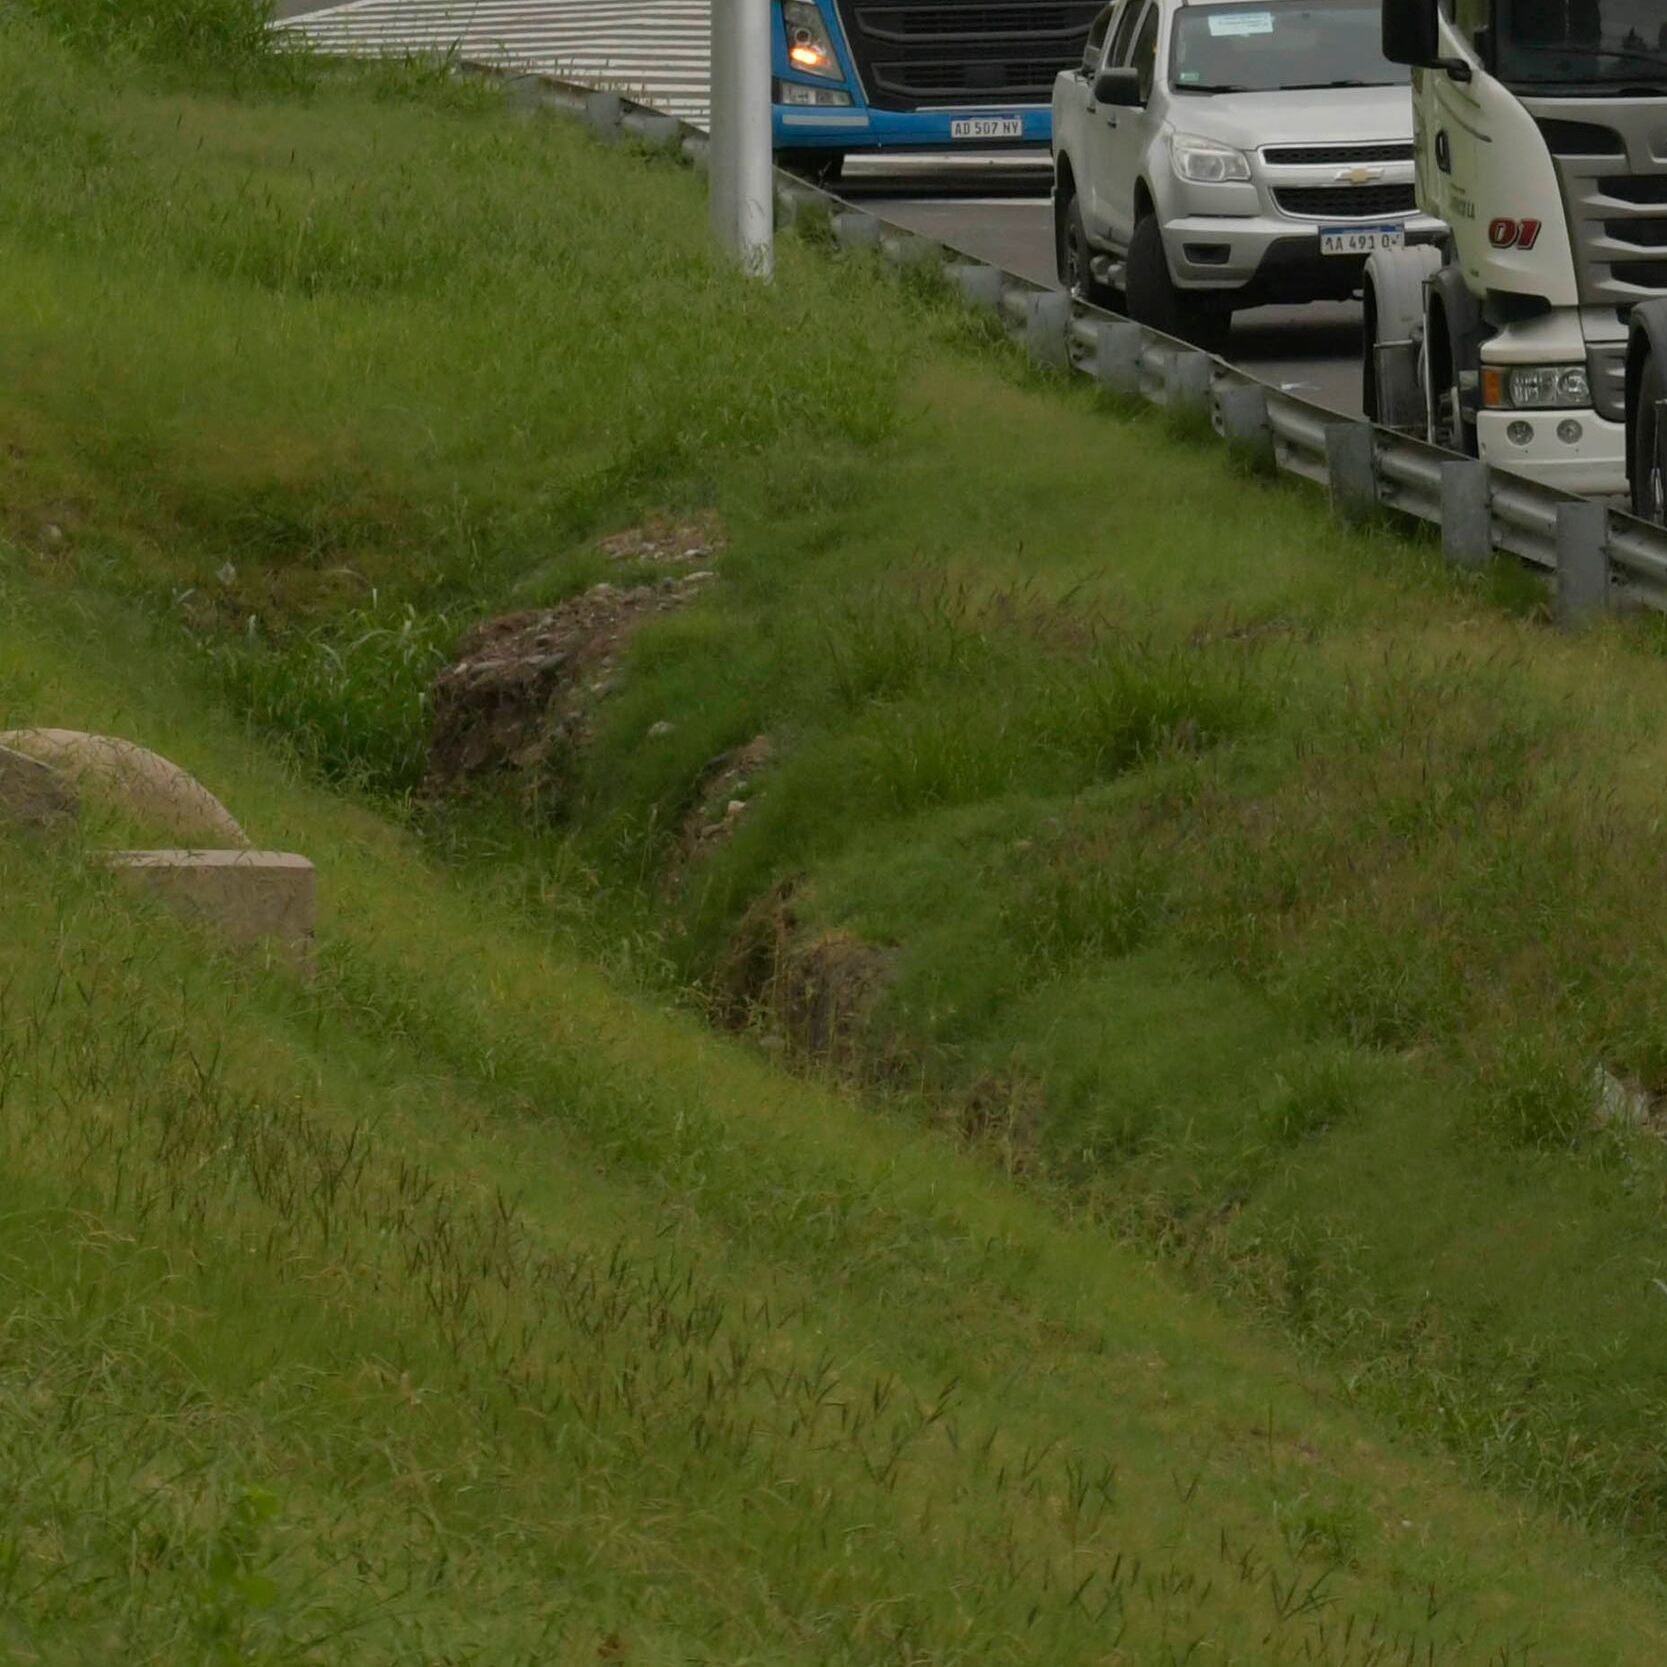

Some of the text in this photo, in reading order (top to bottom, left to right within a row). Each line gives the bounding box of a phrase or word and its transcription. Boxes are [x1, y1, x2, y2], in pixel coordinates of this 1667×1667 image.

[955, 121, 1019, 136] AD 507 NY
[1489, 217, 1542, 250] 01
[1349, 235, 1375, 249] 491
